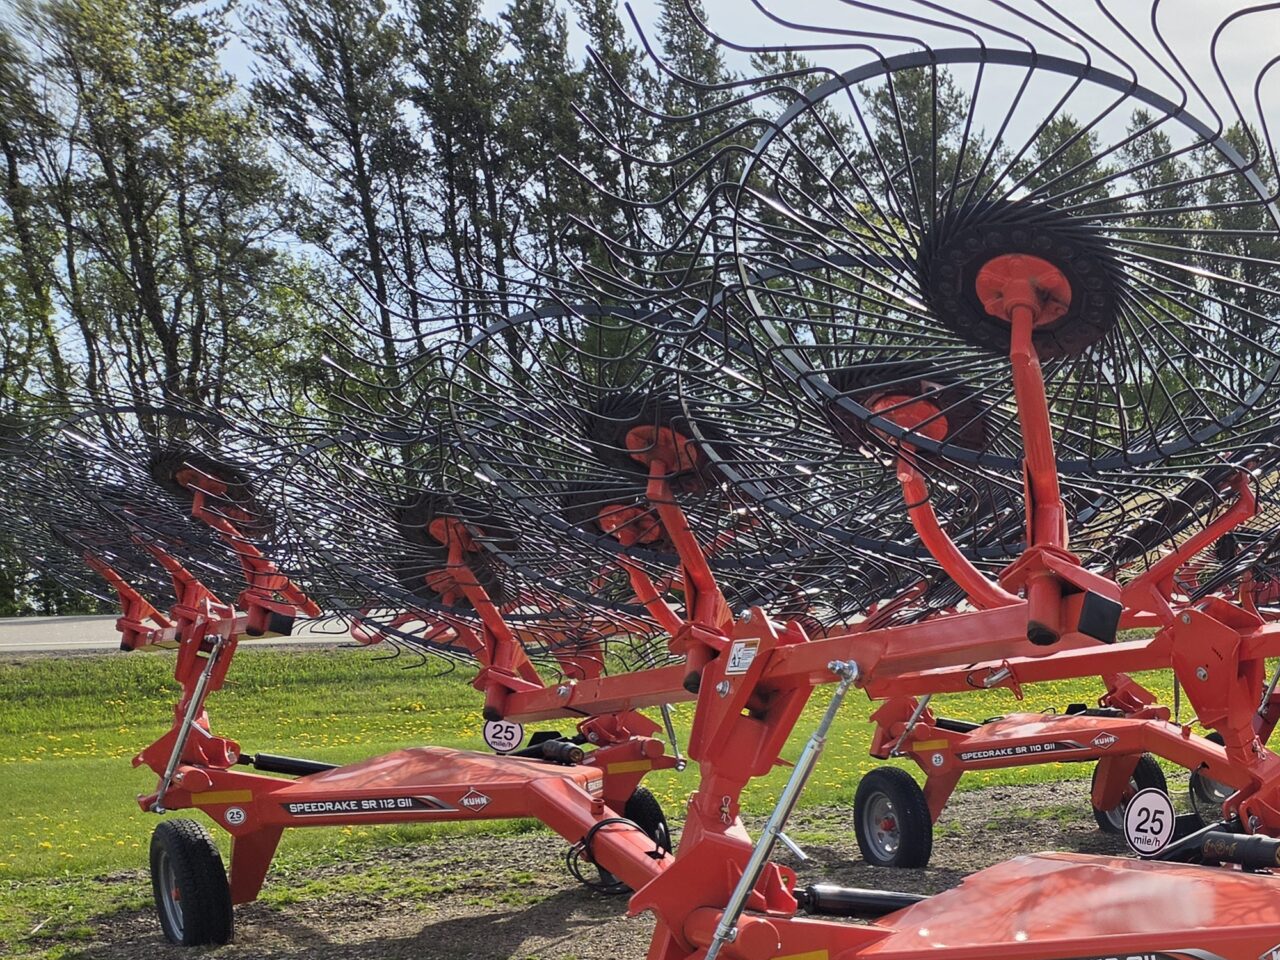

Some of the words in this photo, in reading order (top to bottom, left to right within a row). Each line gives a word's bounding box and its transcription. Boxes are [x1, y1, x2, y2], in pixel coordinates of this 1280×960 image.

[491, 724, 515, 741] 25
[1094, 736, 1115, 745] KUHN
[961, 748, 1013, 760] SPEEDRAKE
[1030, 745, 1041, 753] 110
[289, 801, 358, 813] SPEEDRAKE
[361, 800, 378, 809] SR
[379, 799, 395, 809] 112
[397, 798, 412, 808] GII
[463, 796, 487, 806] KUHN
[229, 810, 242, 819] 25
[1135, 807, 1165, 835] 25
[1133, 835, 1161, 847] mile/h
